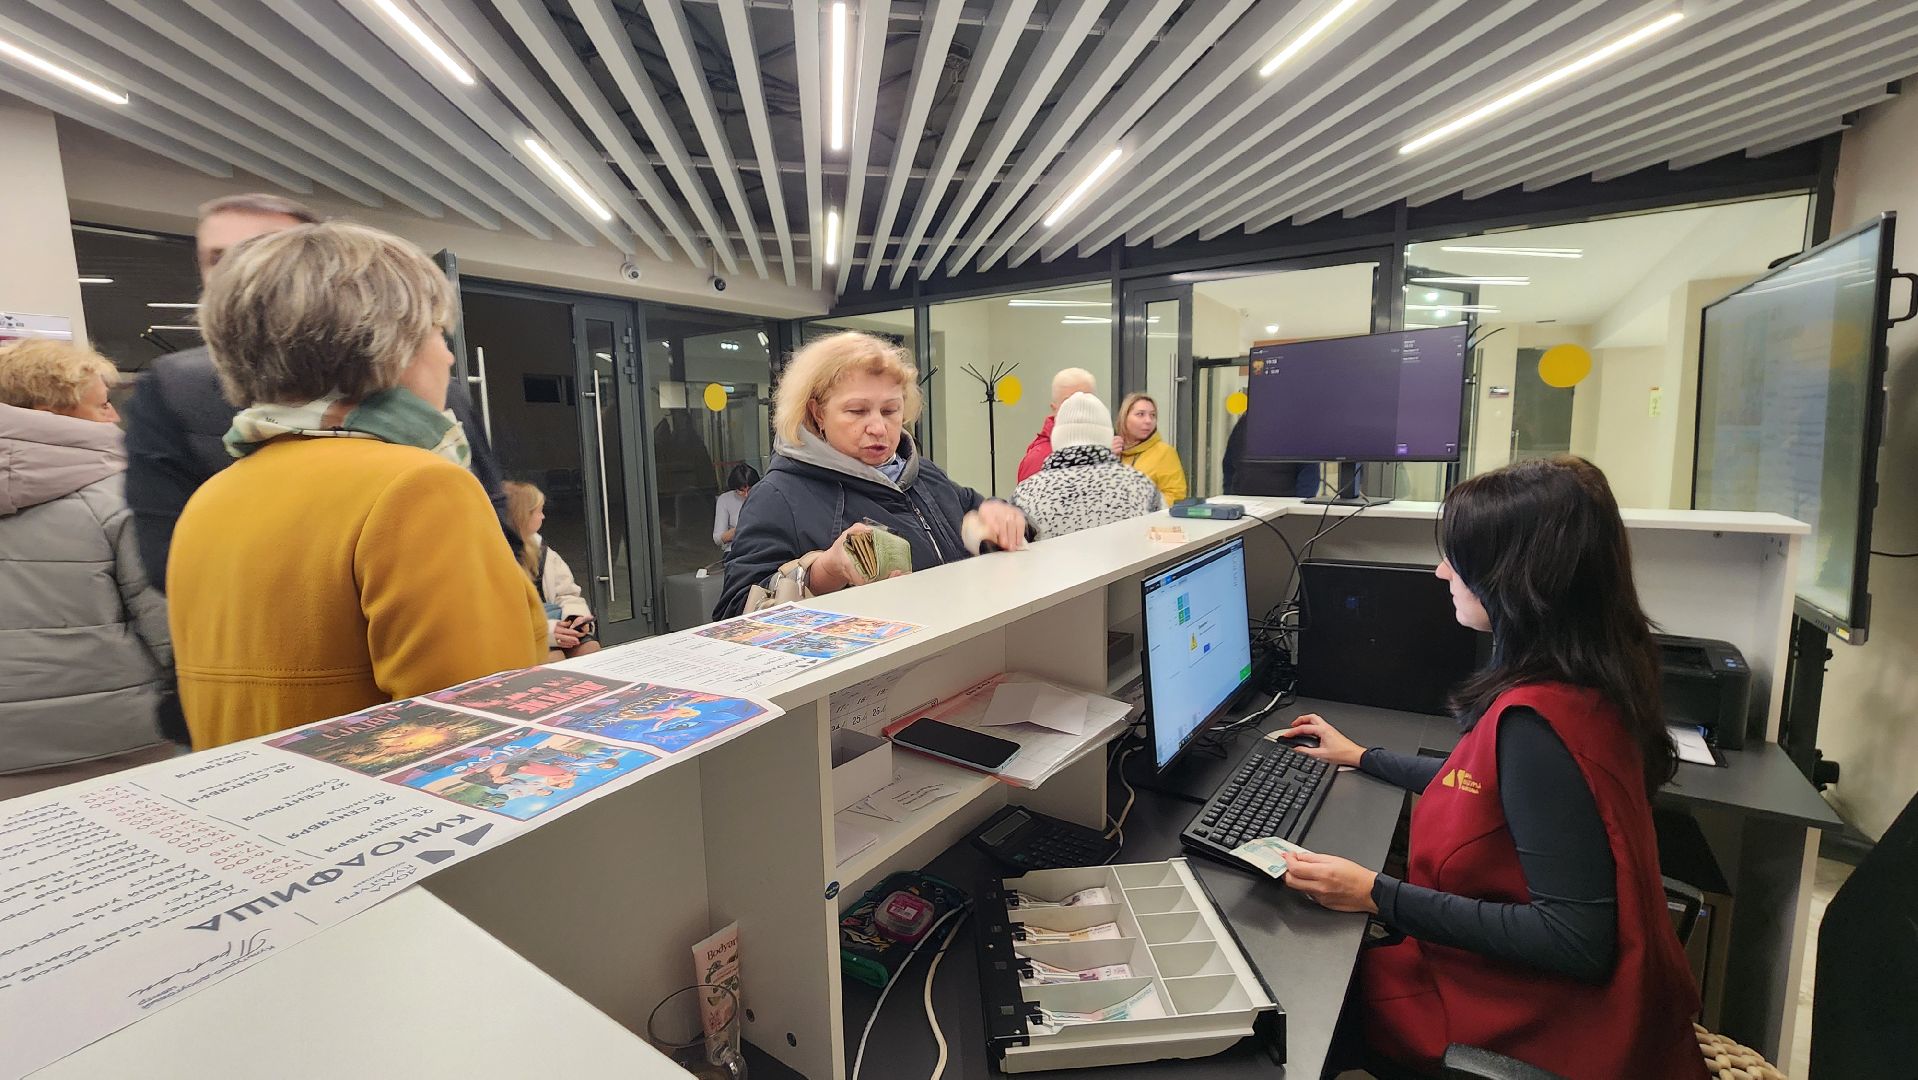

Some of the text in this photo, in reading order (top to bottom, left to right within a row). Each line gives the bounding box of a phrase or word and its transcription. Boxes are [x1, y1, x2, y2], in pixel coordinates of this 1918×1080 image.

[174, 753, 246, 778] ОКТЯБРЯ
[186, 764, 295, 803] 28 СЕНТЯБРЯ
[241, 781, 350, 821] 27 СЕНТЯБРЯ
[325, 791, 386, 815] Пятница
[31, 816, 85, 836] Август
[285, 795, 396, 839] 26 СЕНТЯБРЯ
[323, 808, 434, 852] 25 СЕНТЯБРЯ
[26, 832, 121, 865] Русалочка
[56, 828, 110, 848] Август
[72, 839, 128, 860] Август
[185, 832, 237, 854] 12:00
[208, 839, 252, 857] 19:15
[52, 848, 150, 883] Русалочка
[213, 844, 263, 864] 17:30
[220, 848, 273, 871] 16:00
[71, 857, 170, 894] Русалочка
[129, 862, 186, 887] Август
[187, 814, 473, 930] КИНОАФИША
[251, 858, 301, 880] 17:30
[258, 862, 313, 884] 16:00
[365, 866, 417, 892] ДОМА
[33, 879, 82, 899] улов
[111, 873, 210, 912] Русалочка
[164, 879, 222, 905] Август
[334, 863, 417, 904] КУЛЬТУРЫ
[71, 897, 122, 918] улов
[147, 888, 248, 928] Русалочка
[94, 915, 159, 942] Новая
[20, 938, 120, 982] морской
